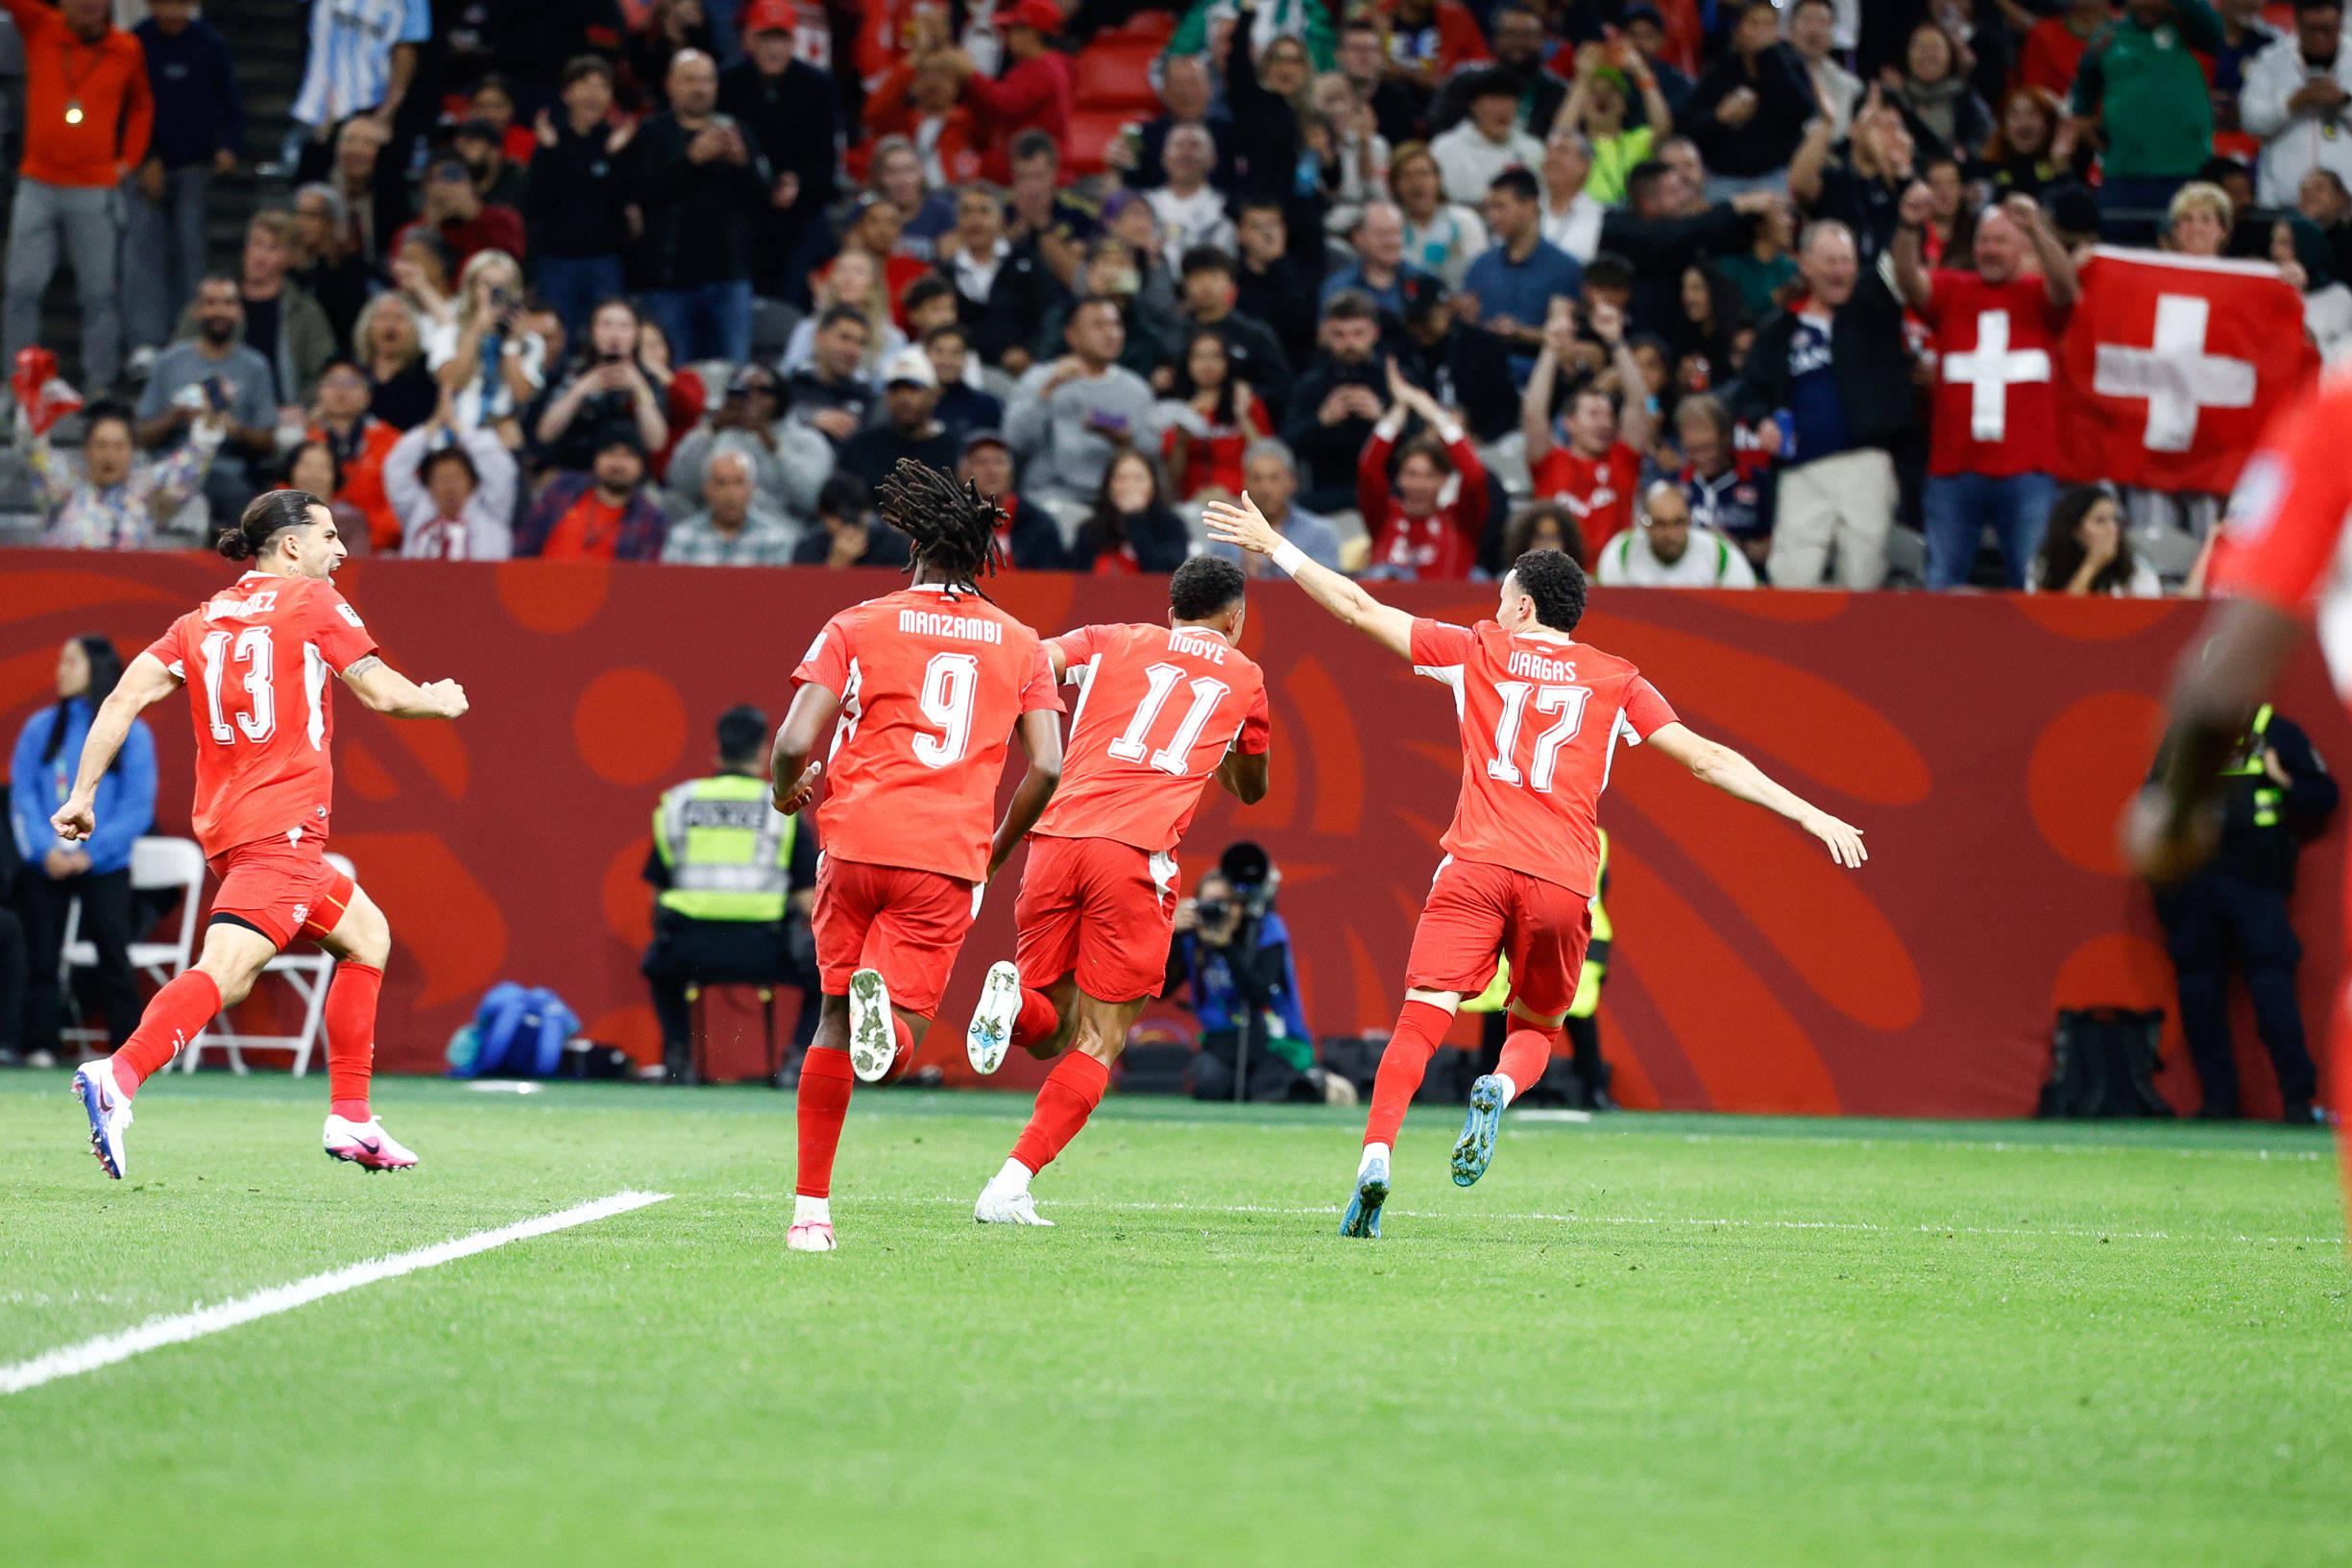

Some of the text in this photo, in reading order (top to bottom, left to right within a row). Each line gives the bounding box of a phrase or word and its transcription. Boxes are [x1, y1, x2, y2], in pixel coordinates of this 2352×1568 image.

[899, 609, 1003, 645] MANZAMBI
[1168, 633, 1228, 666] NDOYE
[1508, 651, 1577, 683] VARGAS
[200, 625, 277, 745] 13
[911, 651, 979, 769] 9
[1107, 662, 1231, 776] 11
[1487, 681, 1593, 793] 17
